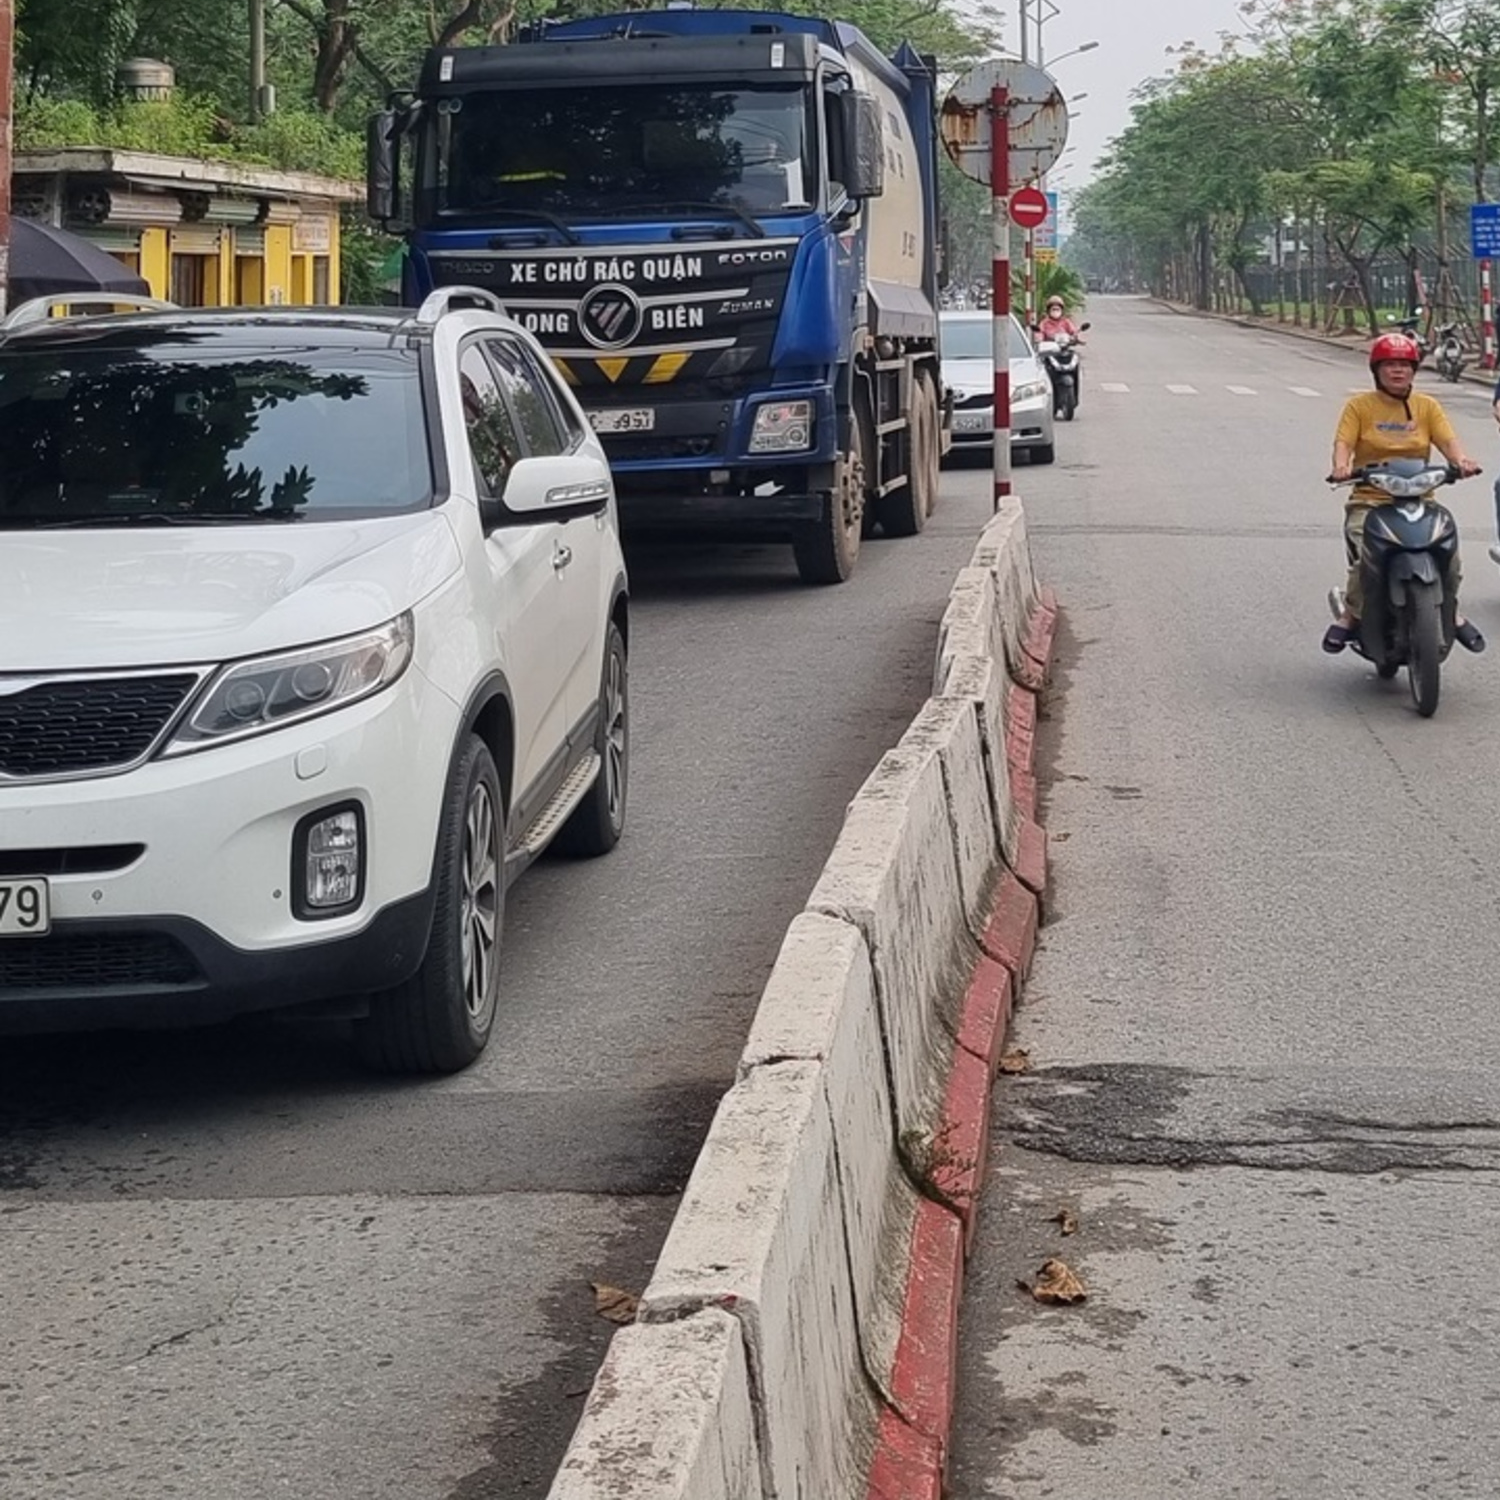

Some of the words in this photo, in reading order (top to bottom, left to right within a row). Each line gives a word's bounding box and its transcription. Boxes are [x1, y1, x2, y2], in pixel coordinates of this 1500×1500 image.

[511, 263, 537, 282] XE
[544, 255, 588, 282] CHỞ
[594, 257, 635, 281] RÁC
[642, 253, 702, 281] QUẬN
[718, 250, 787, 264] FOTON
[652, 305, 704, 329] BIÊN
[0, 885, 39, 928] 79
